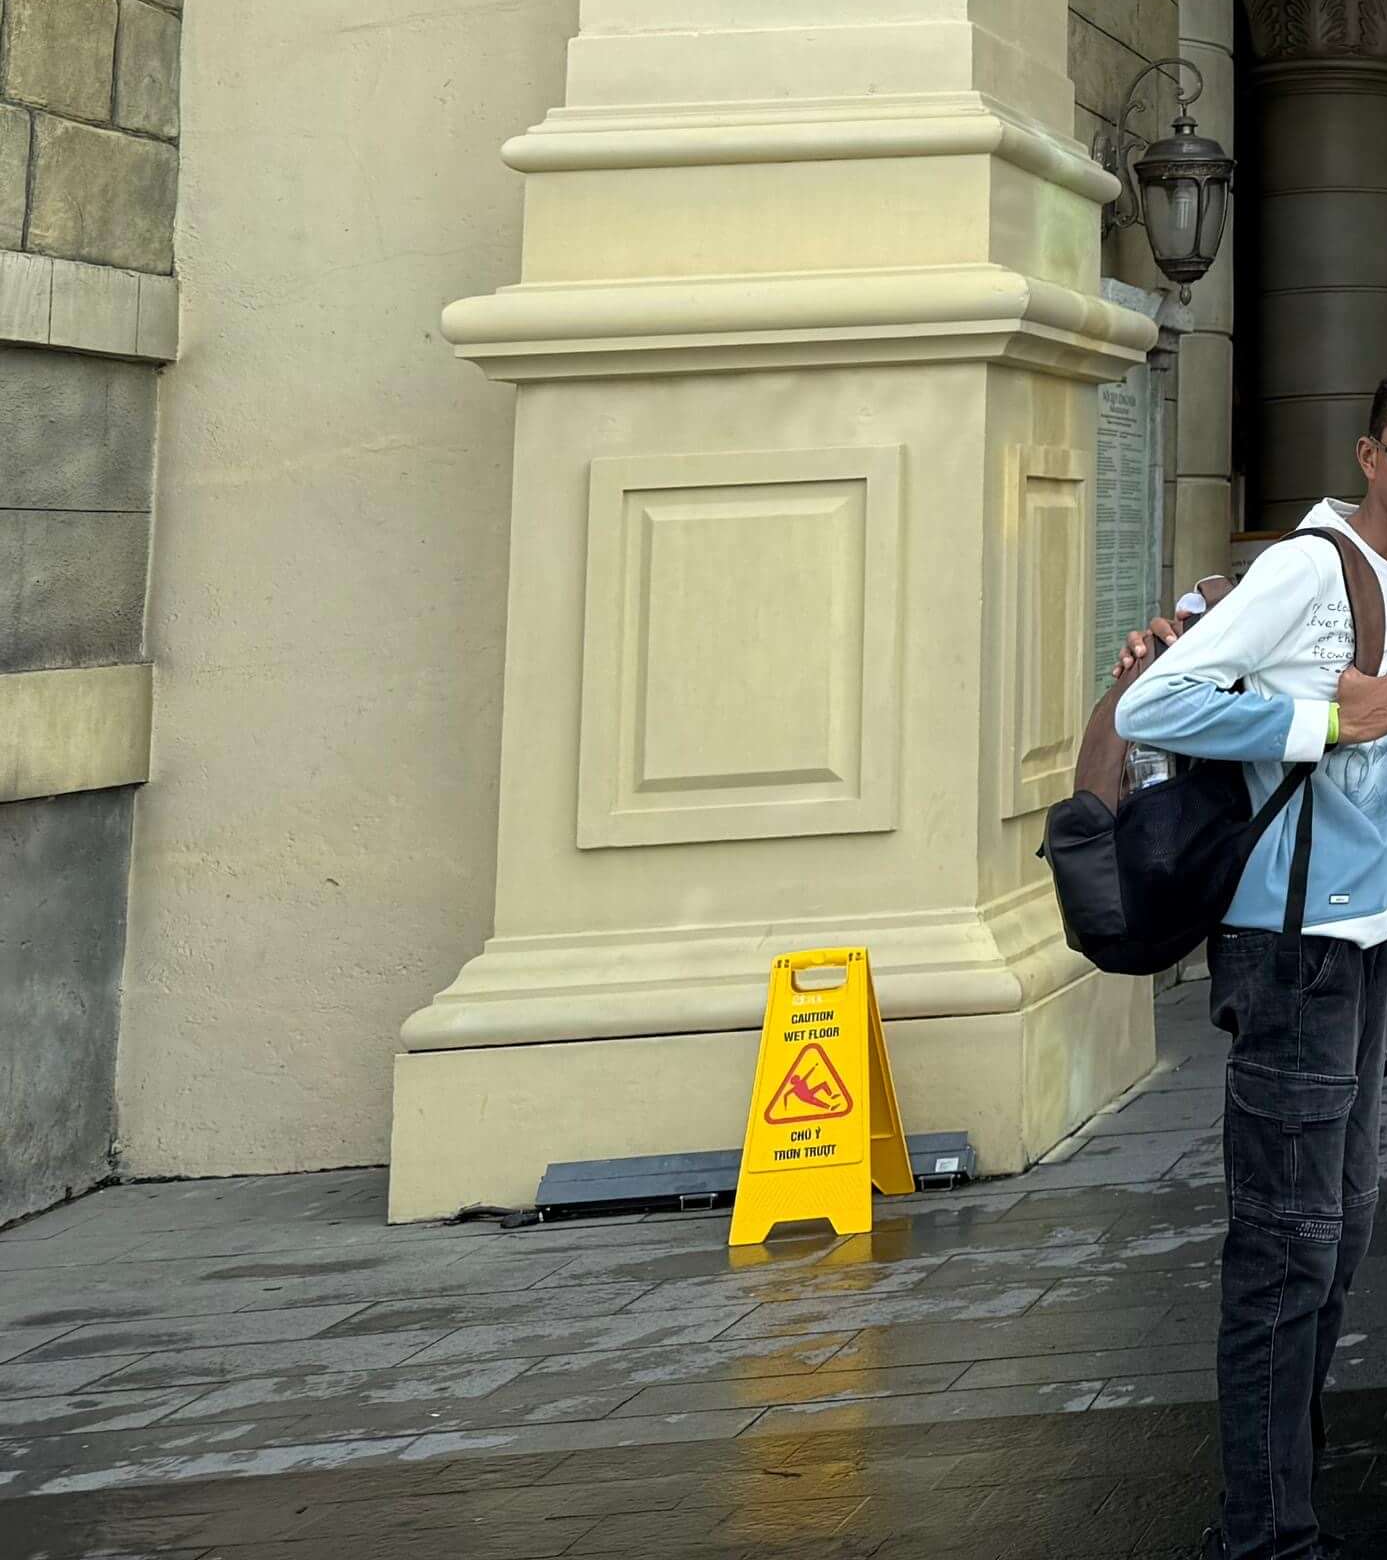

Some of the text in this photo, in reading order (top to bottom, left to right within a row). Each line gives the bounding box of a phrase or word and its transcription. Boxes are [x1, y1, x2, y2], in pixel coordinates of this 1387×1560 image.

[791, 1010, 834, 1025] CAUTION
[784, 1026, 840, 1042] WET FLOOR
